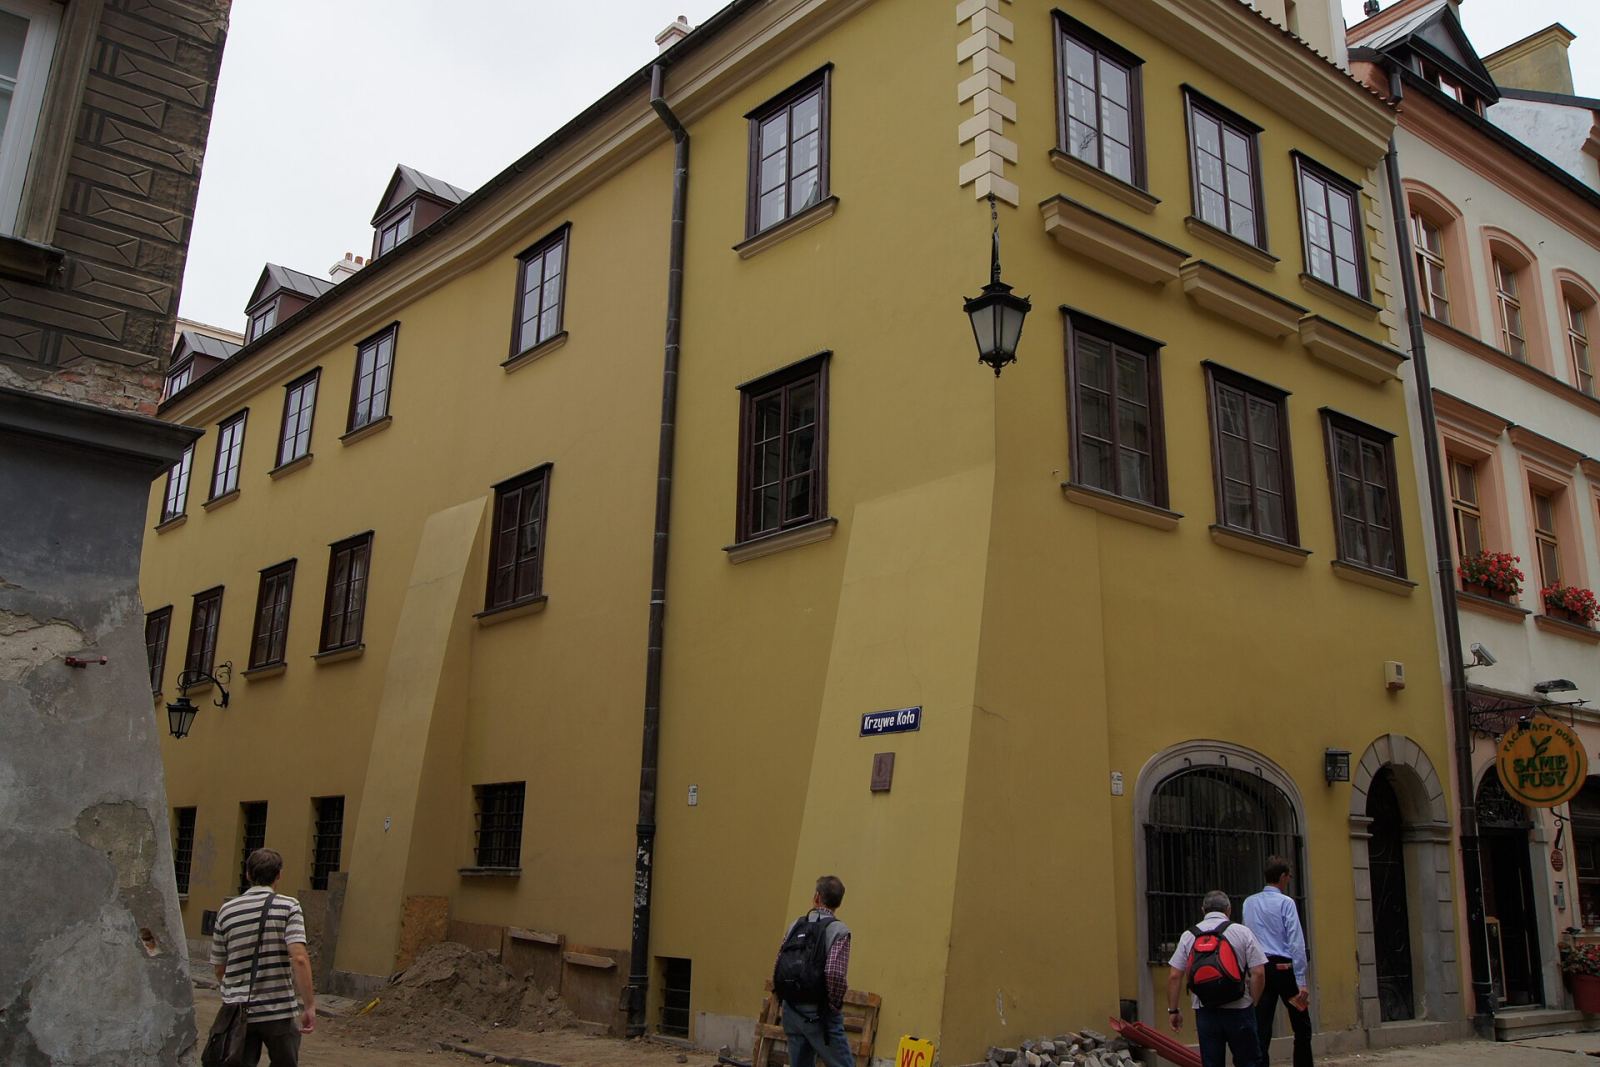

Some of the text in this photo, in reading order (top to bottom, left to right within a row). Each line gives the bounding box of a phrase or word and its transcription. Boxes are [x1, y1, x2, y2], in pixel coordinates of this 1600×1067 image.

[864, 711, 915, 731] Krzywe Koło
[1513, 755, 1568, 773] SAME
[901, 1048, 925, 1067] WC
